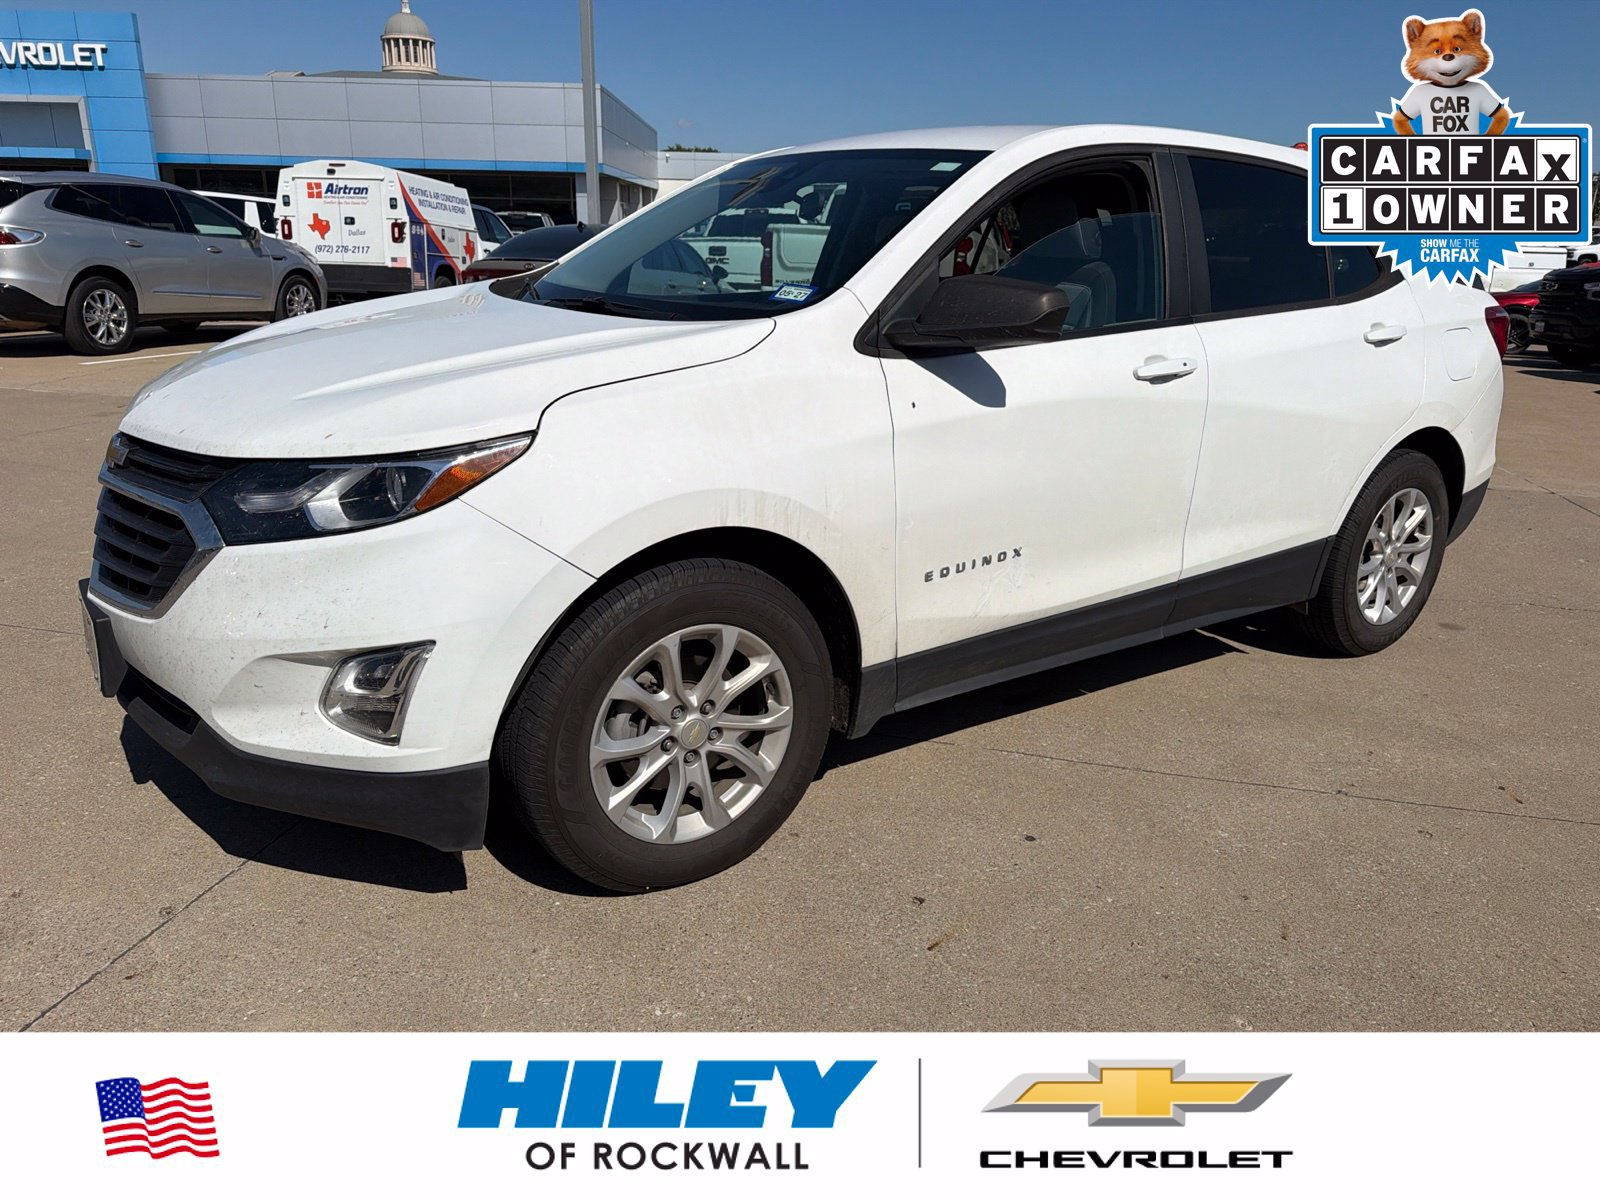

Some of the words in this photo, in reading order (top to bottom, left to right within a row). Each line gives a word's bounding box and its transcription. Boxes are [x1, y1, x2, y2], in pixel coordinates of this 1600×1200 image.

[0, 42, 106, 66] VROLET
[324, 182, 368, 195] Airtron
[408, 186, 428, 198] HEATING
[440, 193, 469, 206] CONDITIONING
[418, 198, 448, 211] INSTALLATION
[452, 205, 466, 215] REPAIR
[315, 245, 333, 254] (972)
[336, 245, 370, 254] 276-2117
[924, 546, 1022, 582] EQUINOX
